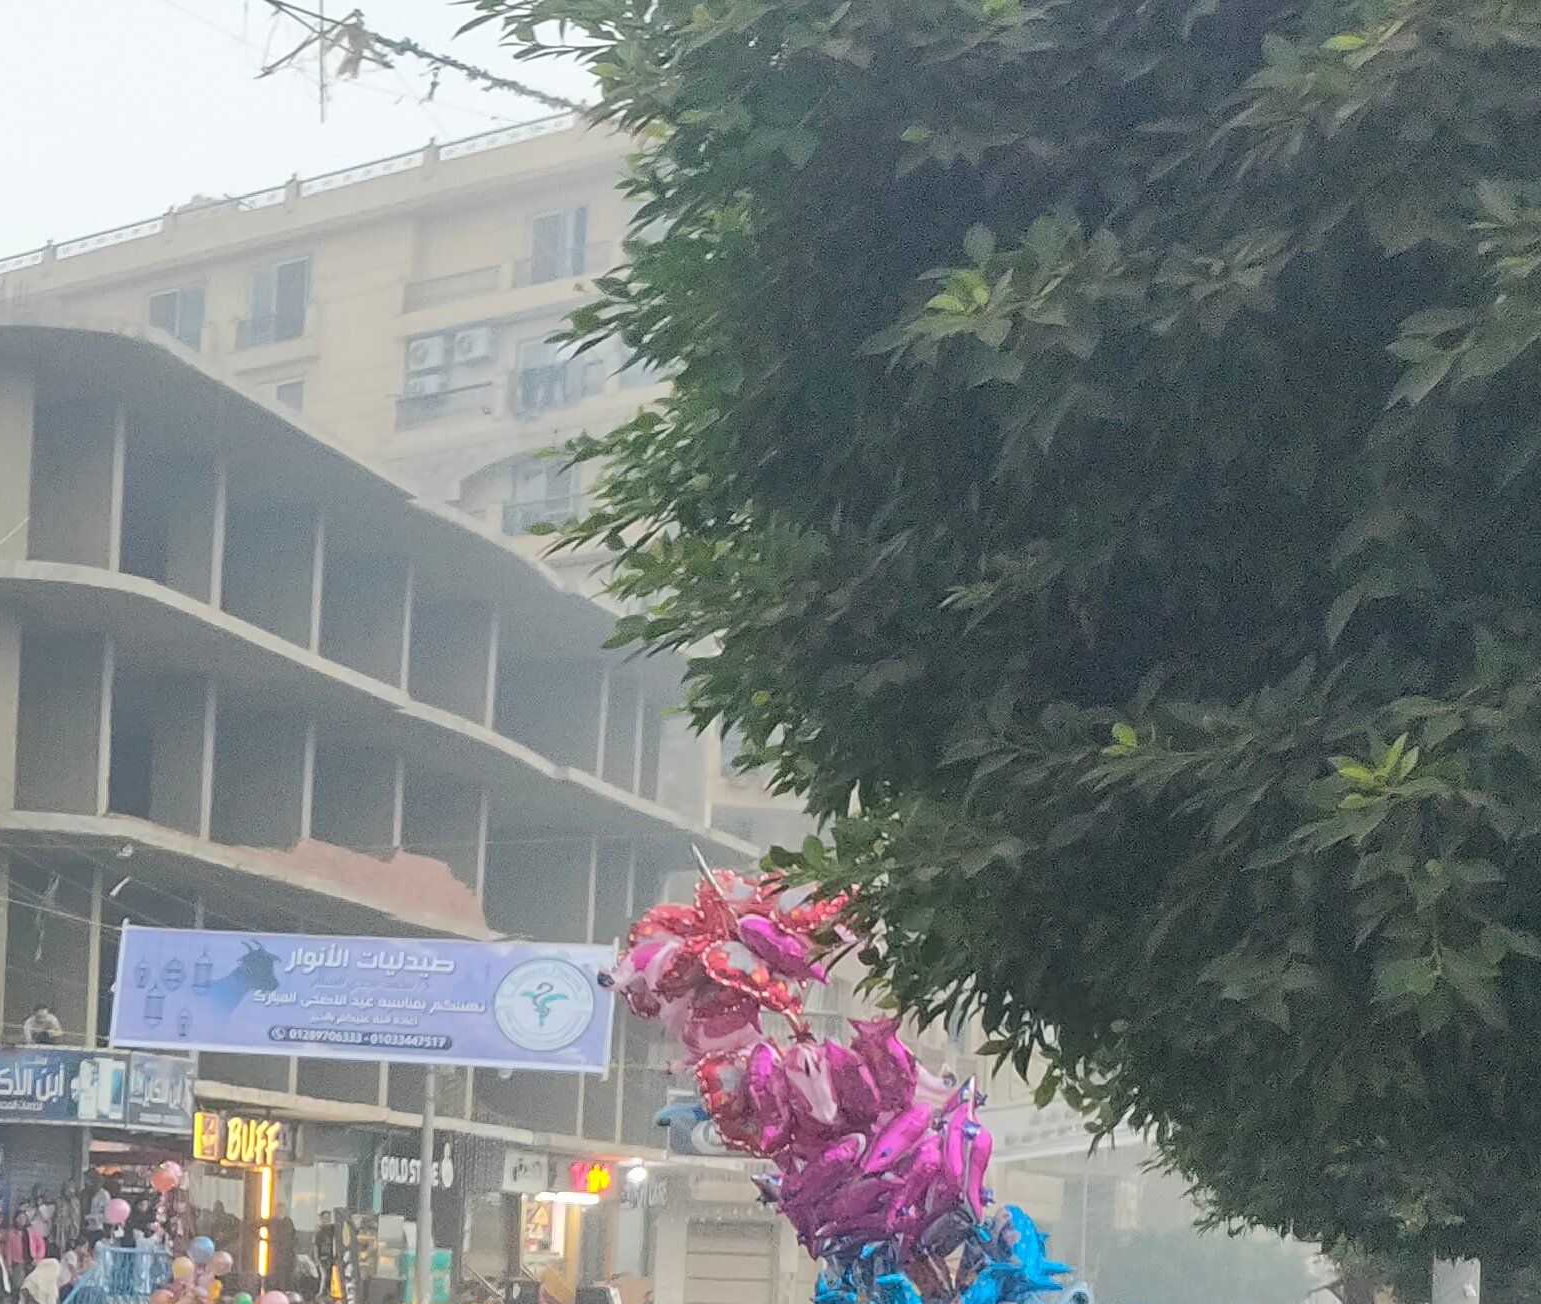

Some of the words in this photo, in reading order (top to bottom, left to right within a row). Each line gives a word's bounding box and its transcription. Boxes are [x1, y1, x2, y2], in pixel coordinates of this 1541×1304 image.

[284, 944, 350, 974] الأنوار
[356, 949, 456, 978] صيدليات
[227, 1117, 280, 1165] BUFF
